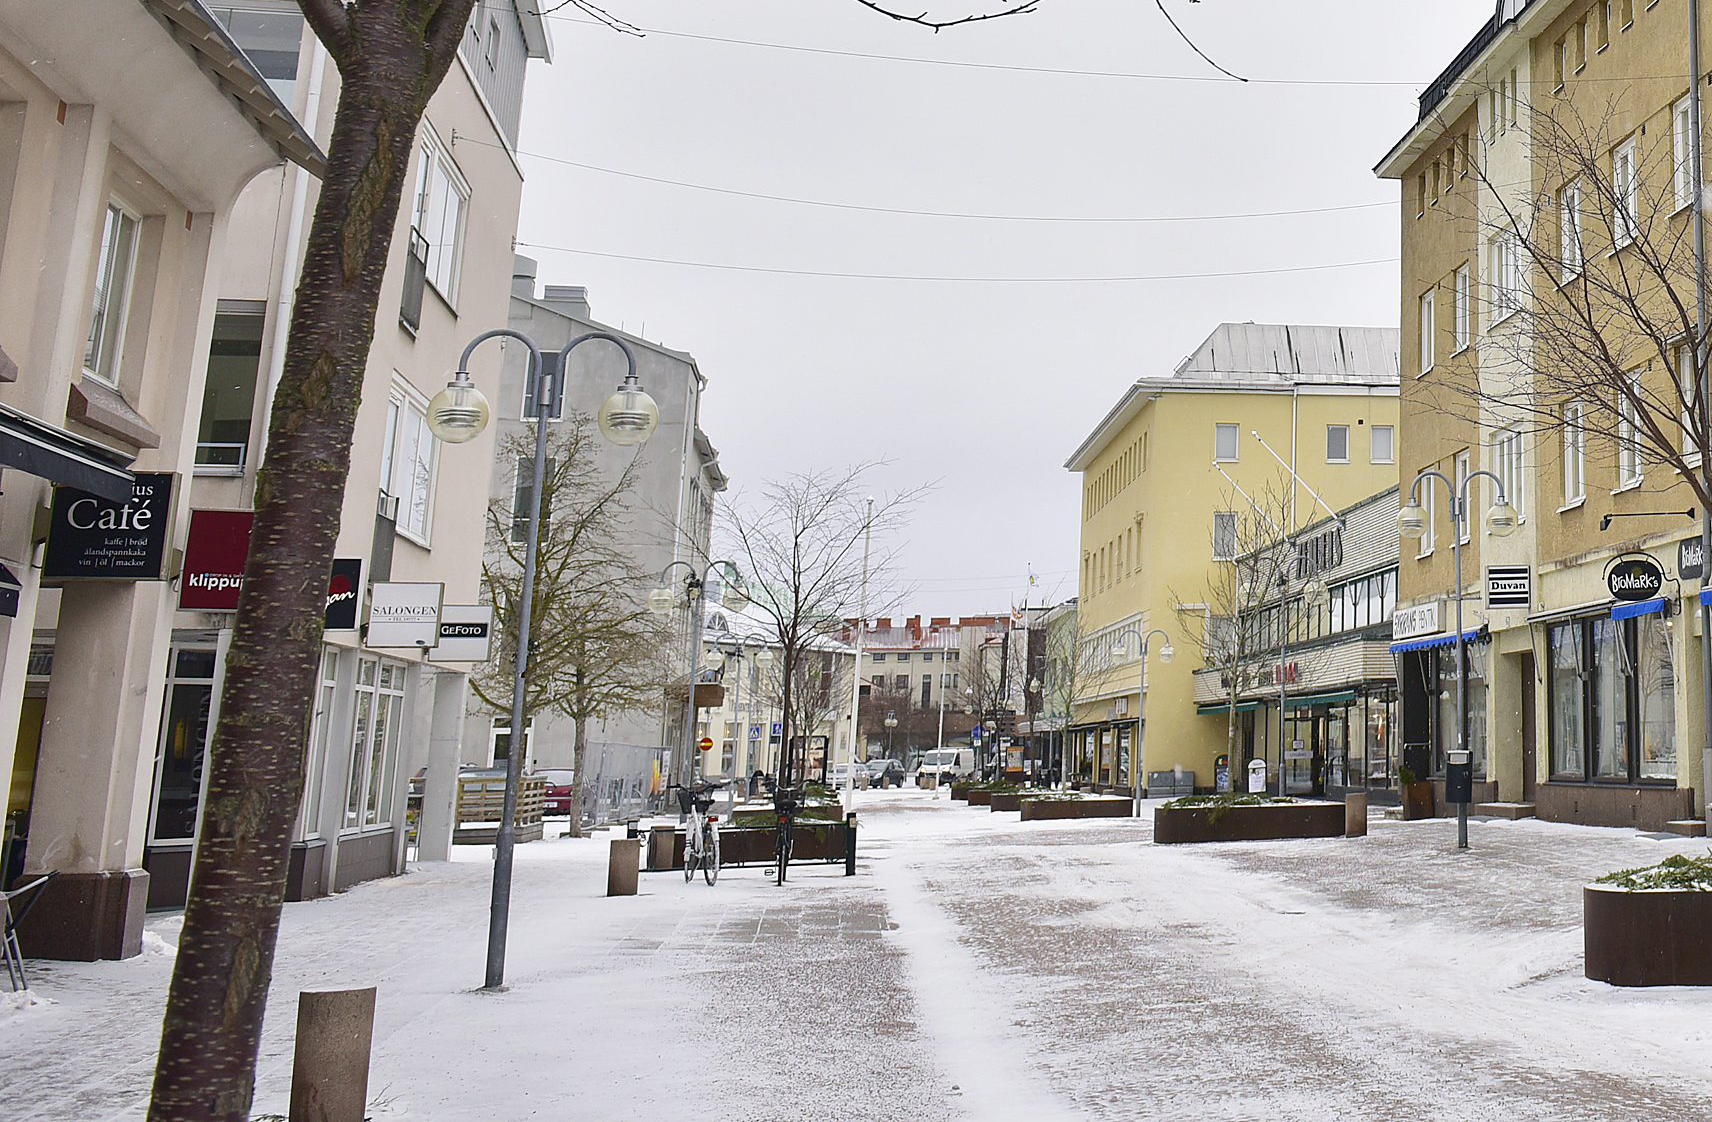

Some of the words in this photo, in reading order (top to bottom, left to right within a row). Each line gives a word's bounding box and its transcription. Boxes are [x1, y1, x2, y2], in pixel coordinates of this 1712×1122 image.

[67, 498, 152, 530] Café
[104, 537, 124, 546] kaffe
[129, 537, 148, 546] bröd
[84, 547, 146, 557] ålandspannkaka
[100, 558, 108, 566] öl
[1491, 581, 1526, 590] Duvan
[372, 606, 438, 615] SALONGEN
